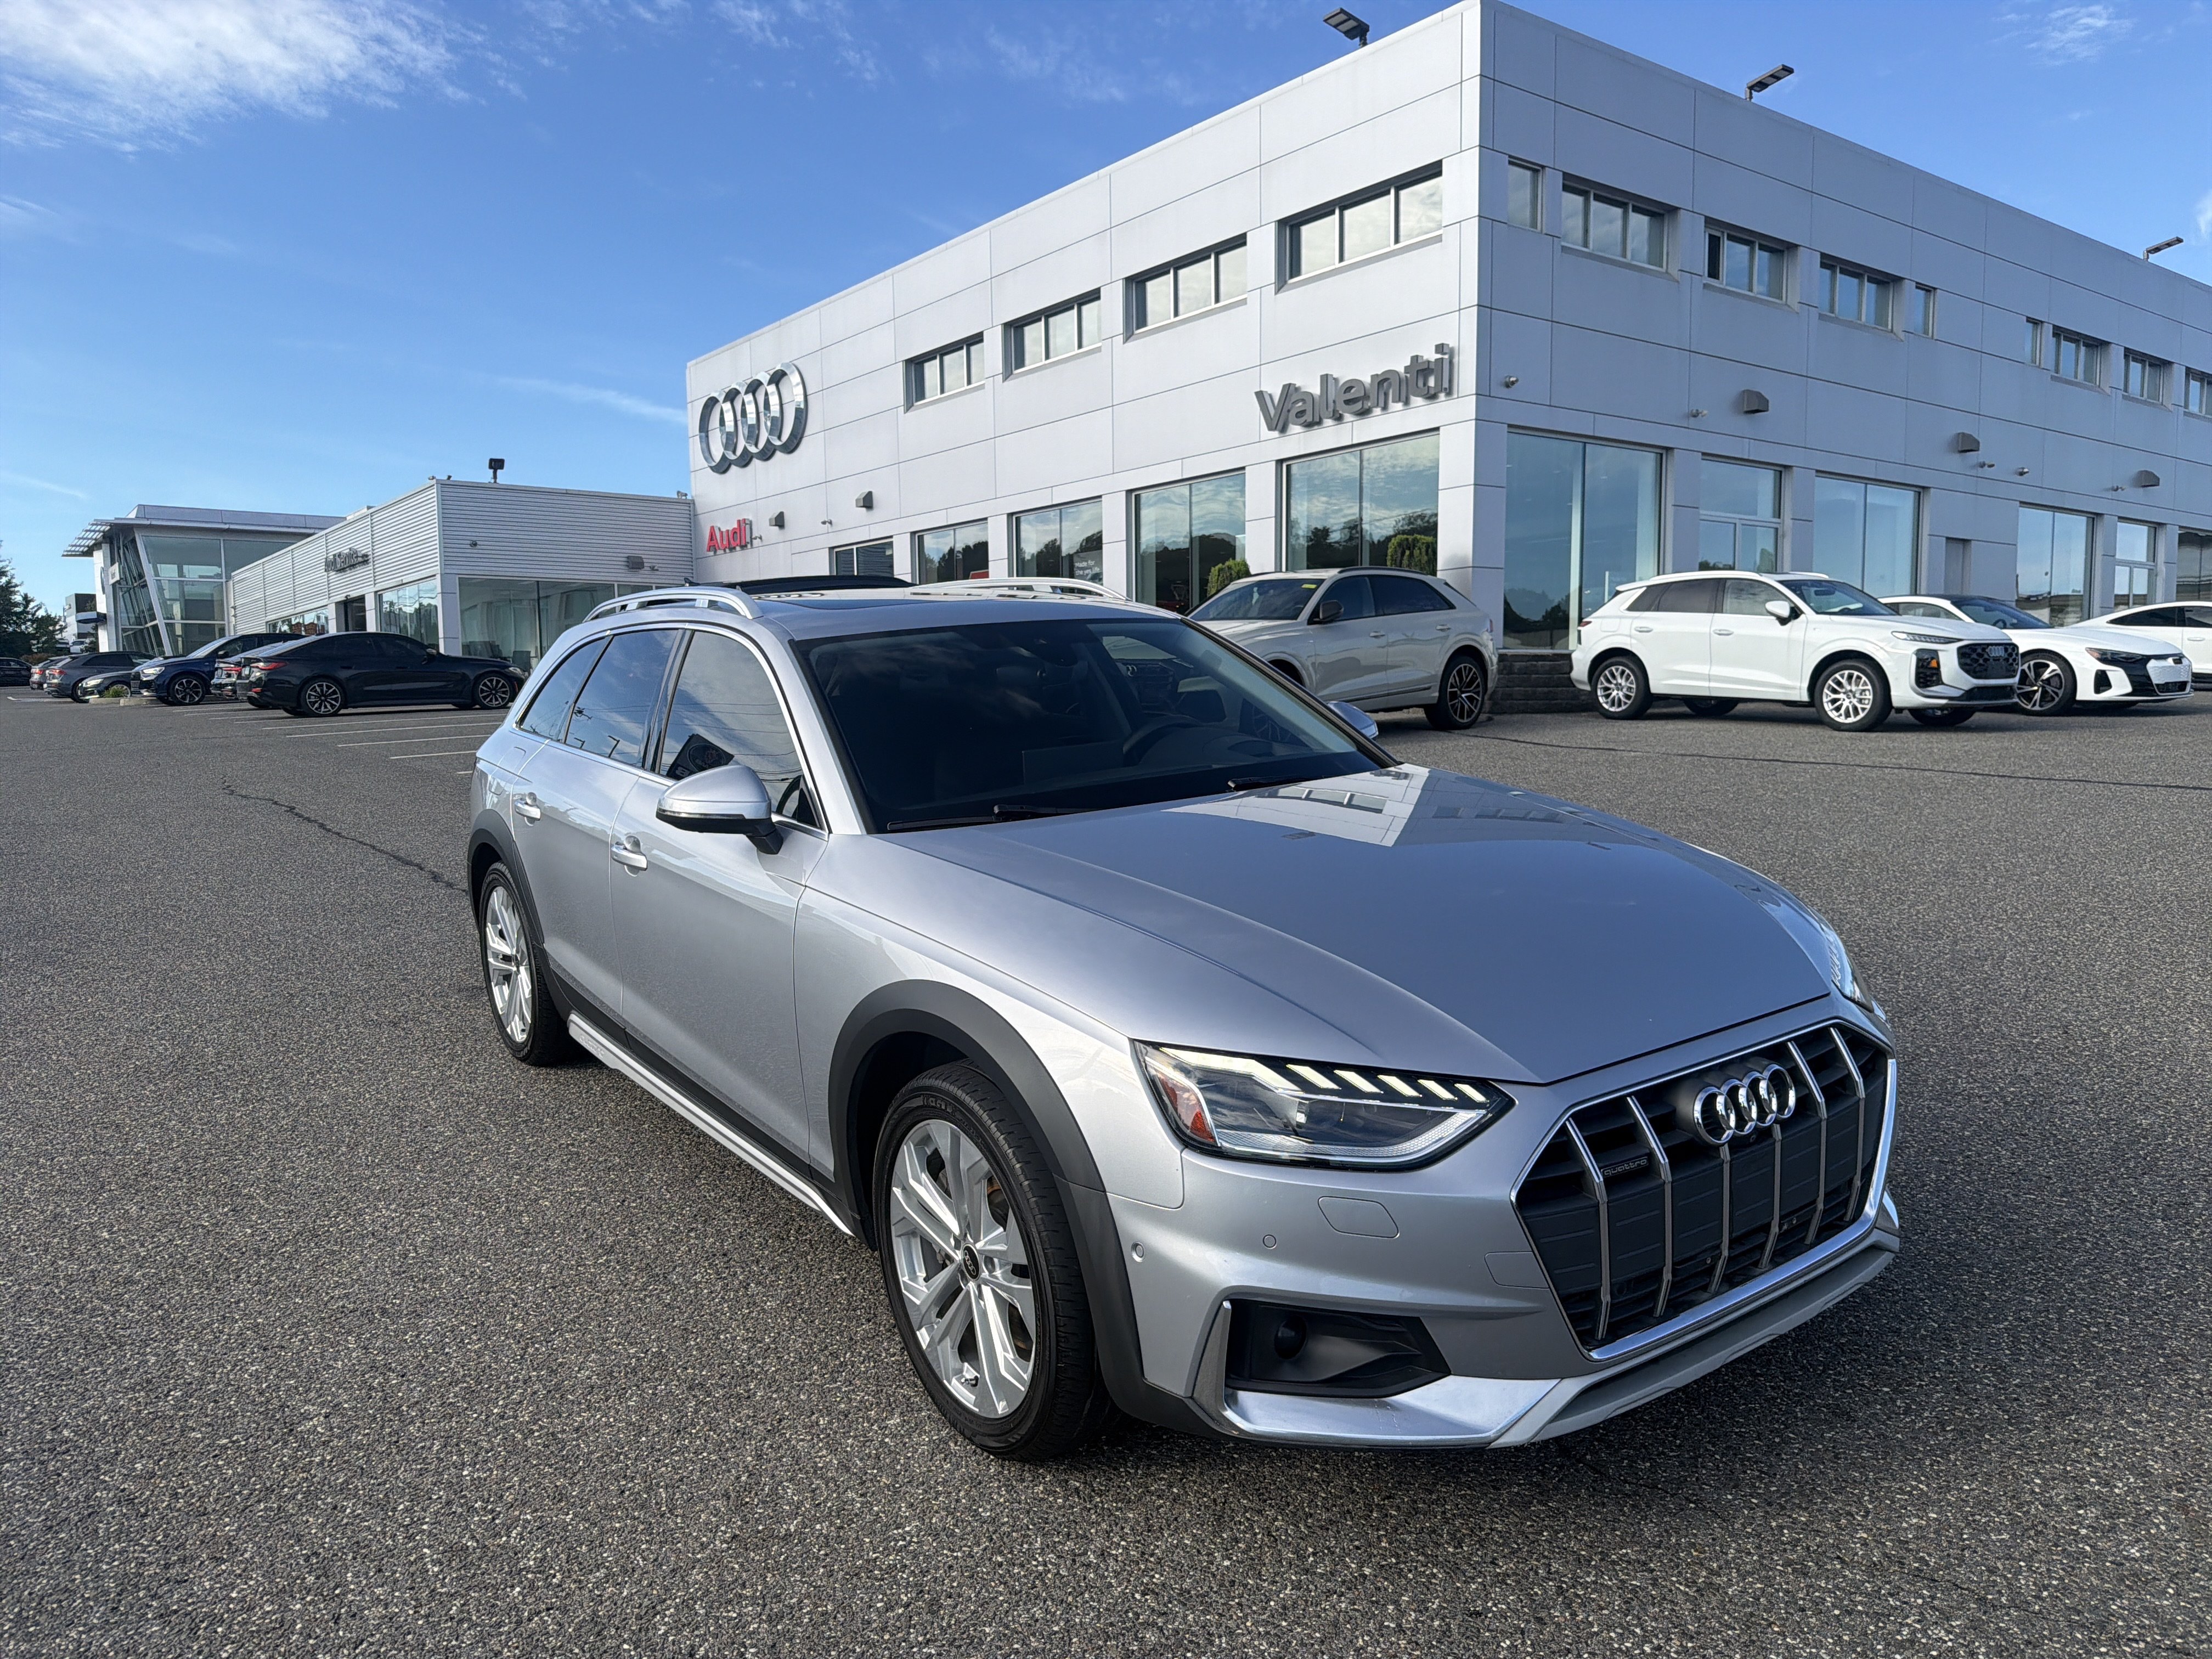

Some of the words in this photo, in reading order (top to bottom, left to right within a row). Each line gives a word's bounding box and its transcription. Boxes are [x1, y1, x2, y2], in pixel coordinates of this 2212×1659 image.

[1255, 343, 1452, 433] Valenti
[706, 518, 748, 552] Audi
[324, 553, 337, 572] Audi
[337, 548, 359, 569] Service
[1604, 1159, 1647, 1176] quattro
